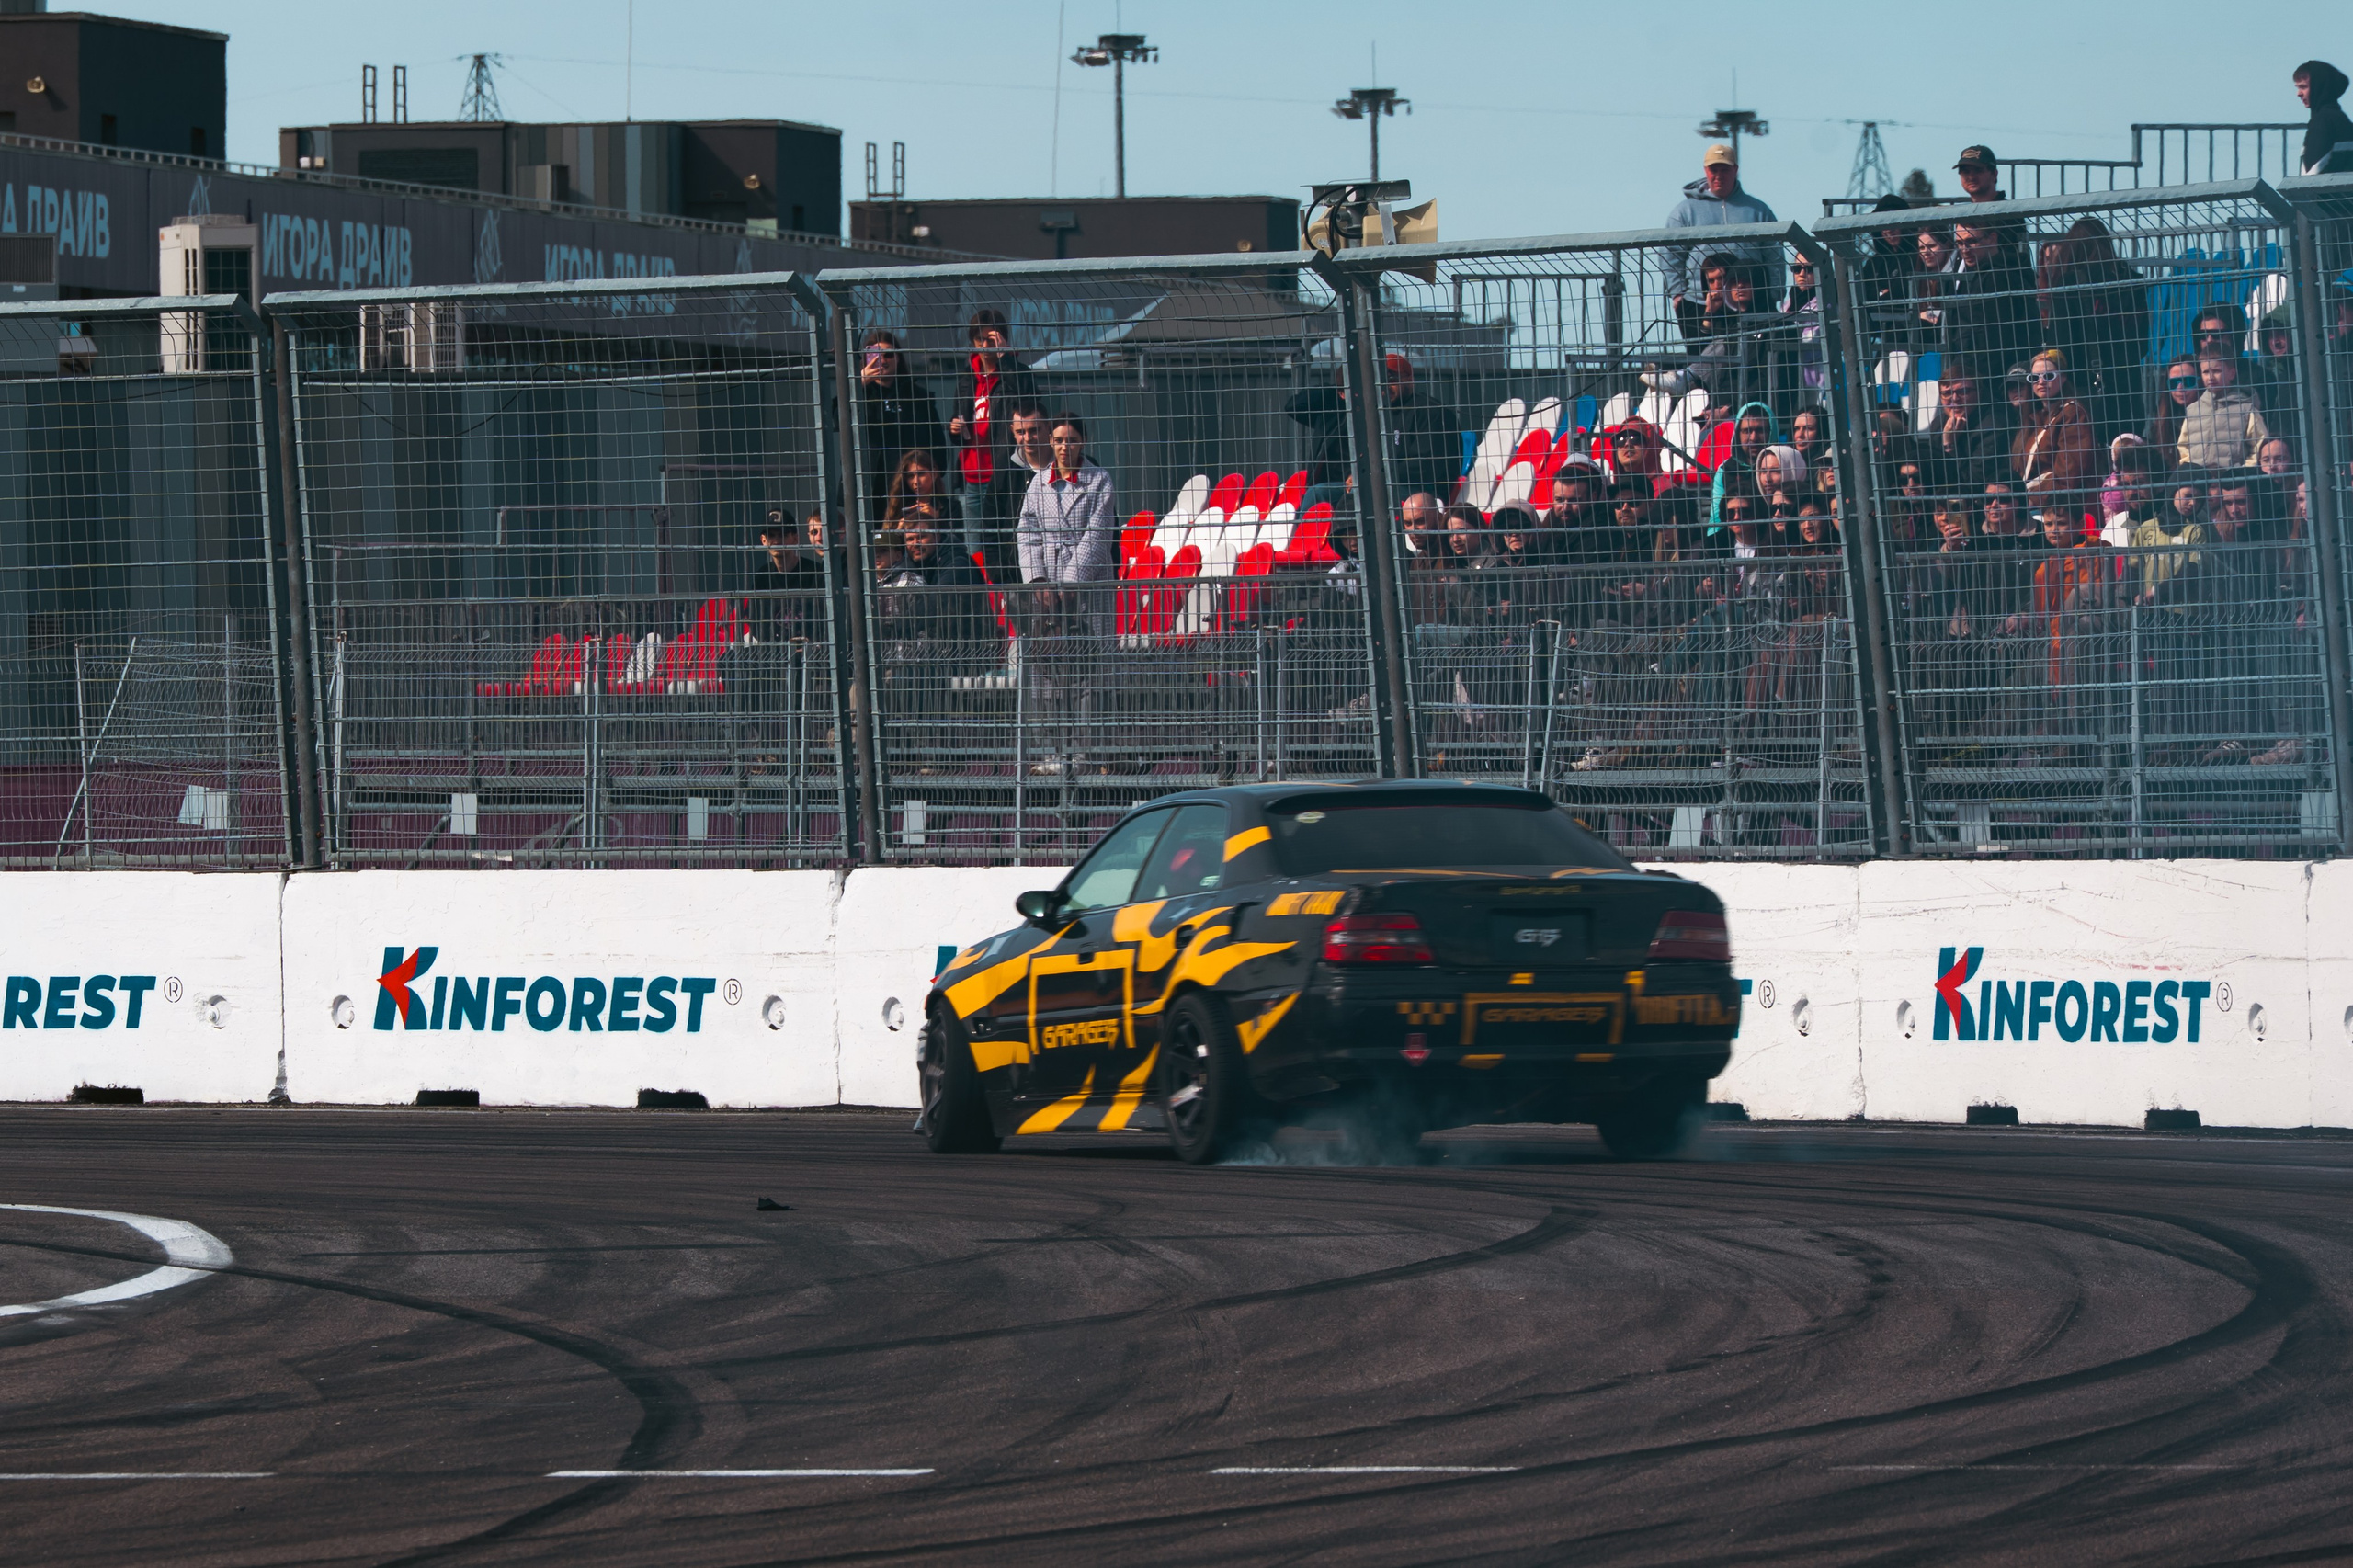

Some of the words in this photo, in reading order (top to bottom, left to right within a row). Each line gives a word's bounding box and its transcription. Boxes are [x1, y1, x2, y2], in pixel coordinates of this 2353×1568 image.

[263, 212, 334, 282] ИГОРА
[339, 221, 412, 289] ДРАЙВ
[2, 975, 156, 1029] REST
[373, 946, 717, 1032] KINFOREST
[1933, 947, 2211, 1044] KINFOREST
